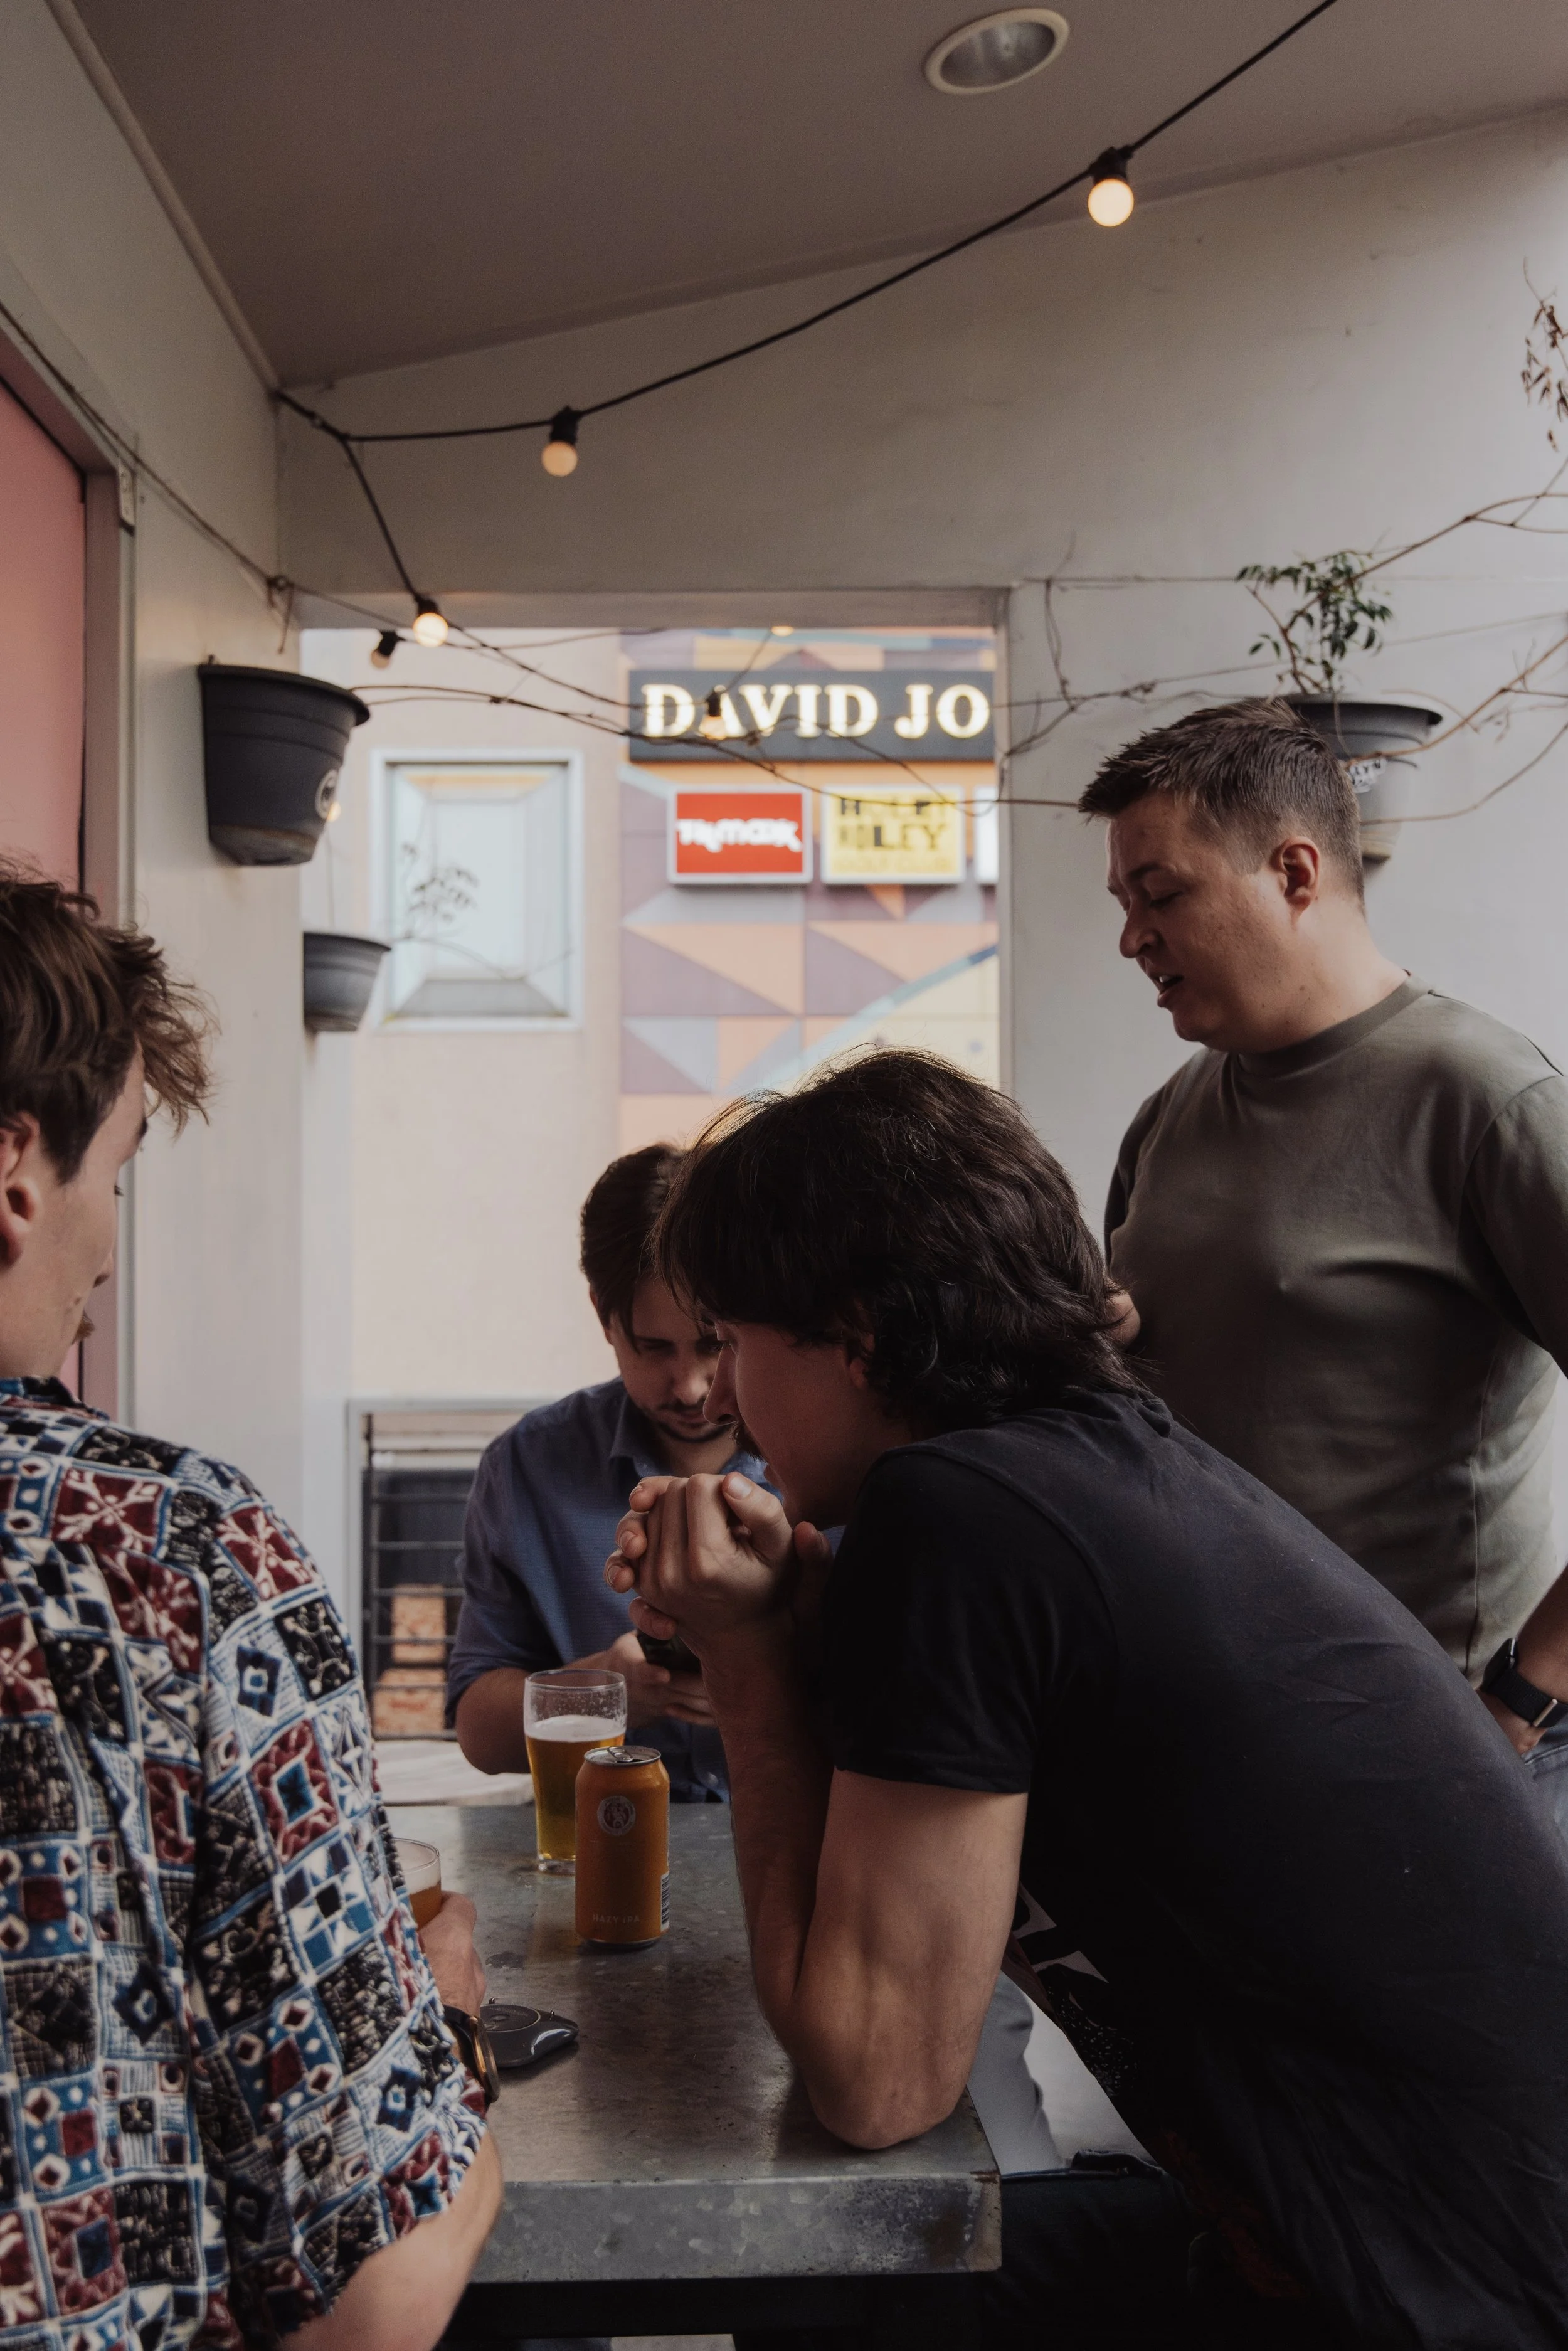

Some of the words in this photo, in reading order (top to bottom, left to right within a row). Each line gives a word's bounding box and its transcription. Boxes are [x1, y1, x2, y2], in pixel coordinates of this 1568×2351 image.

[640, 684, 878, 738] DAVID
[894, 684, 990, 738] JO
[593, 1913, 618, 1924] HAZY
[623, 1914, 640, 1924] IPA
